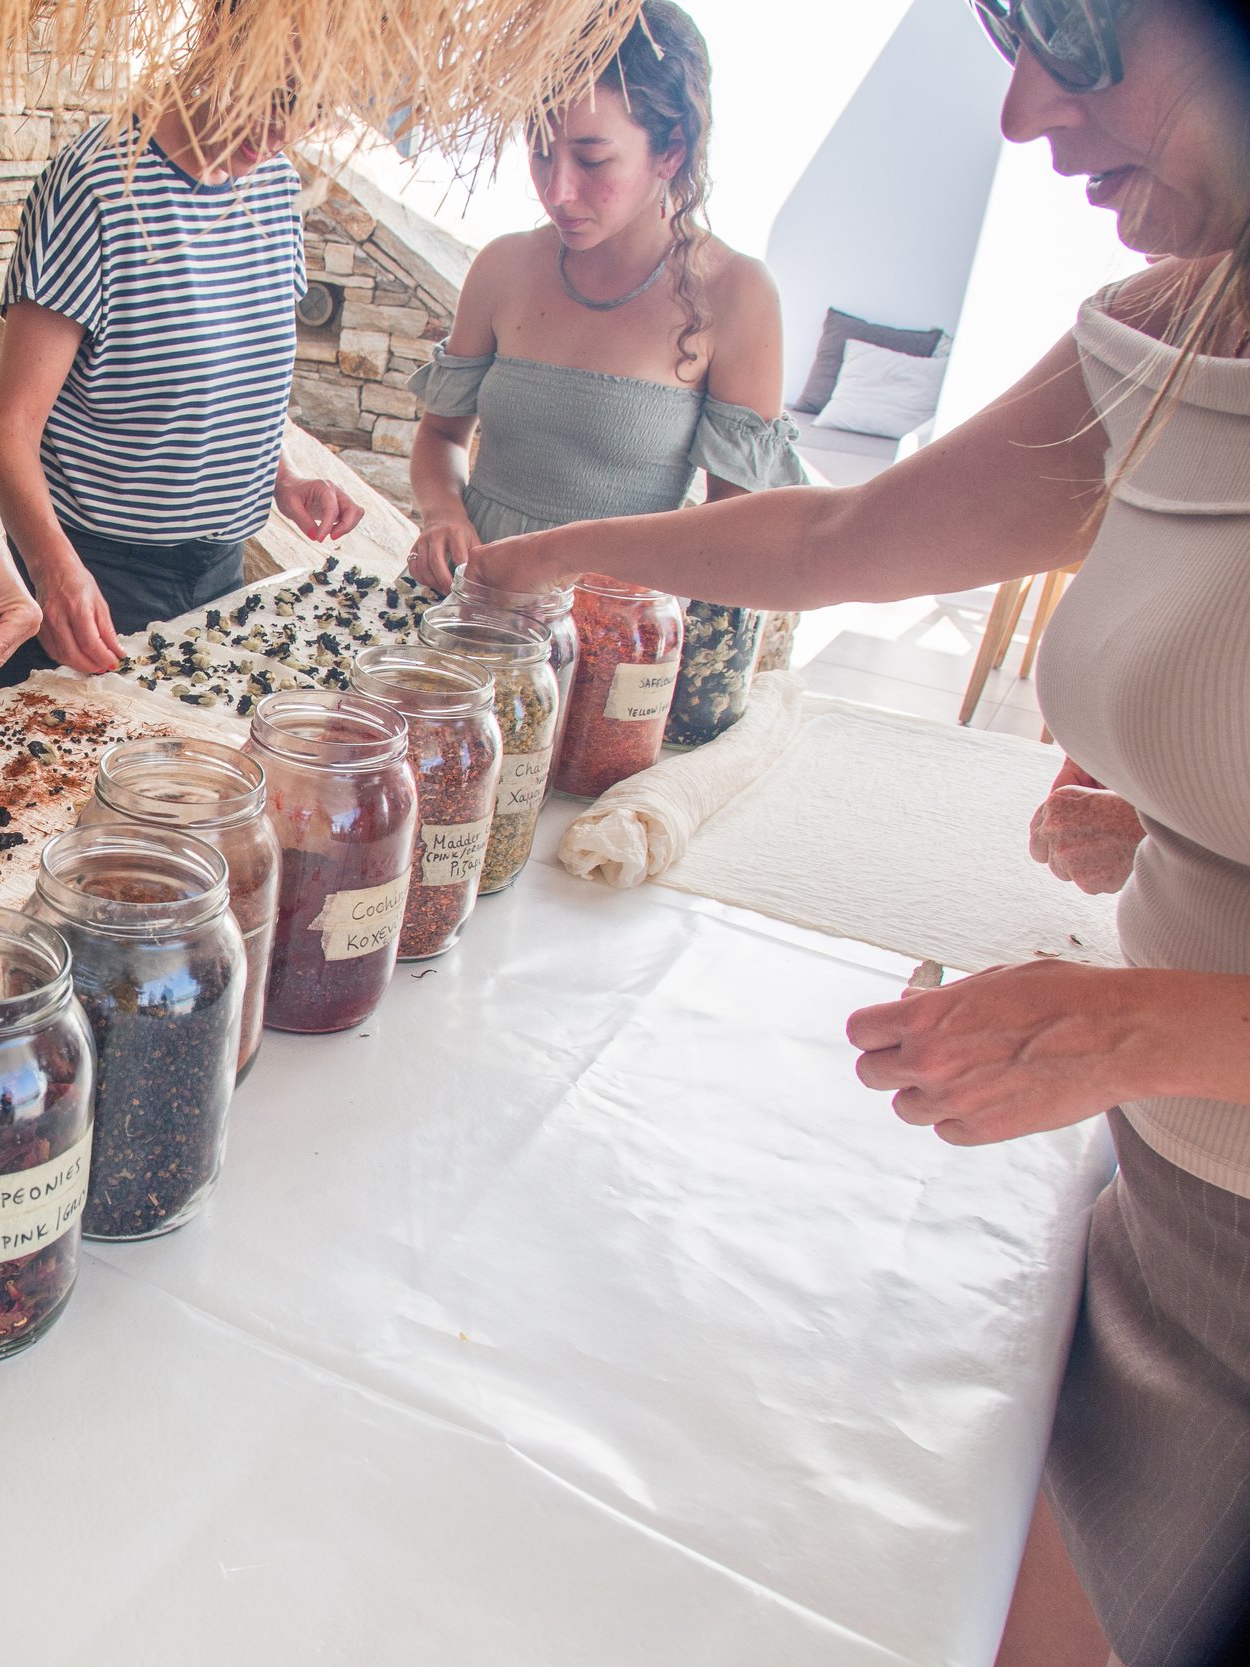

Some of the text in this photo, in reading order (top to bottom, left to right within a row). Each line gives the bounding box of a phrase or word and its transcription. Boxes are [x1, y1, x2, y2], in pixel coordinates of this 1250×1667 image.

[433, 832, 480, 849] Madder
[1, 1157, 81, 1208] PEONIES
[2, 1223, 48, 1249] PINK
